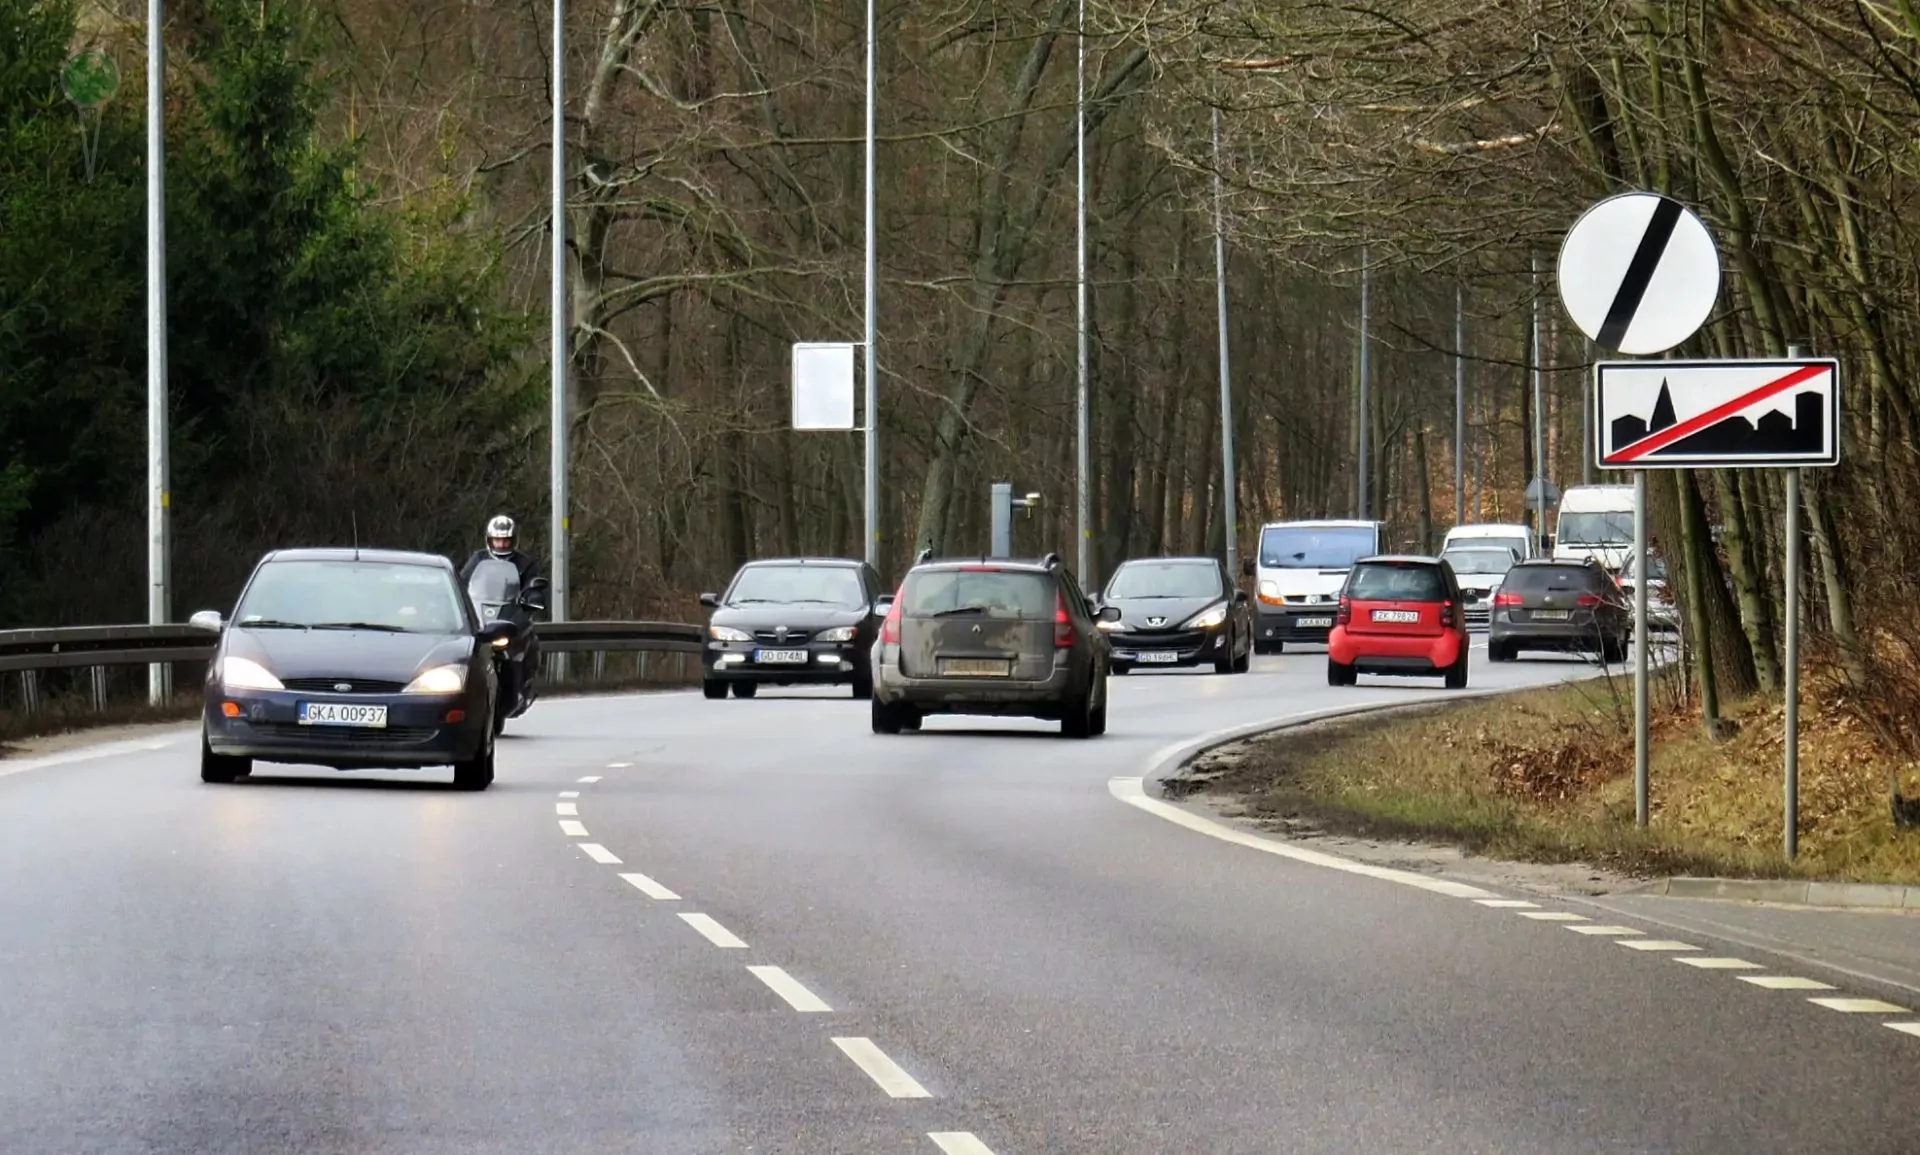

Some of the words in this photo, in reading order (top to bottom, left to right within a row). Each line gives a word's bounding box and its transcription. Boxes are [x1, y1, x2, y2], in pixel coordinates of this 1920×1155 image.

[760, 651, 774, 661] GD
[308, 705, 336, 721] GKA
[340, 706, 385, 722] 00937
